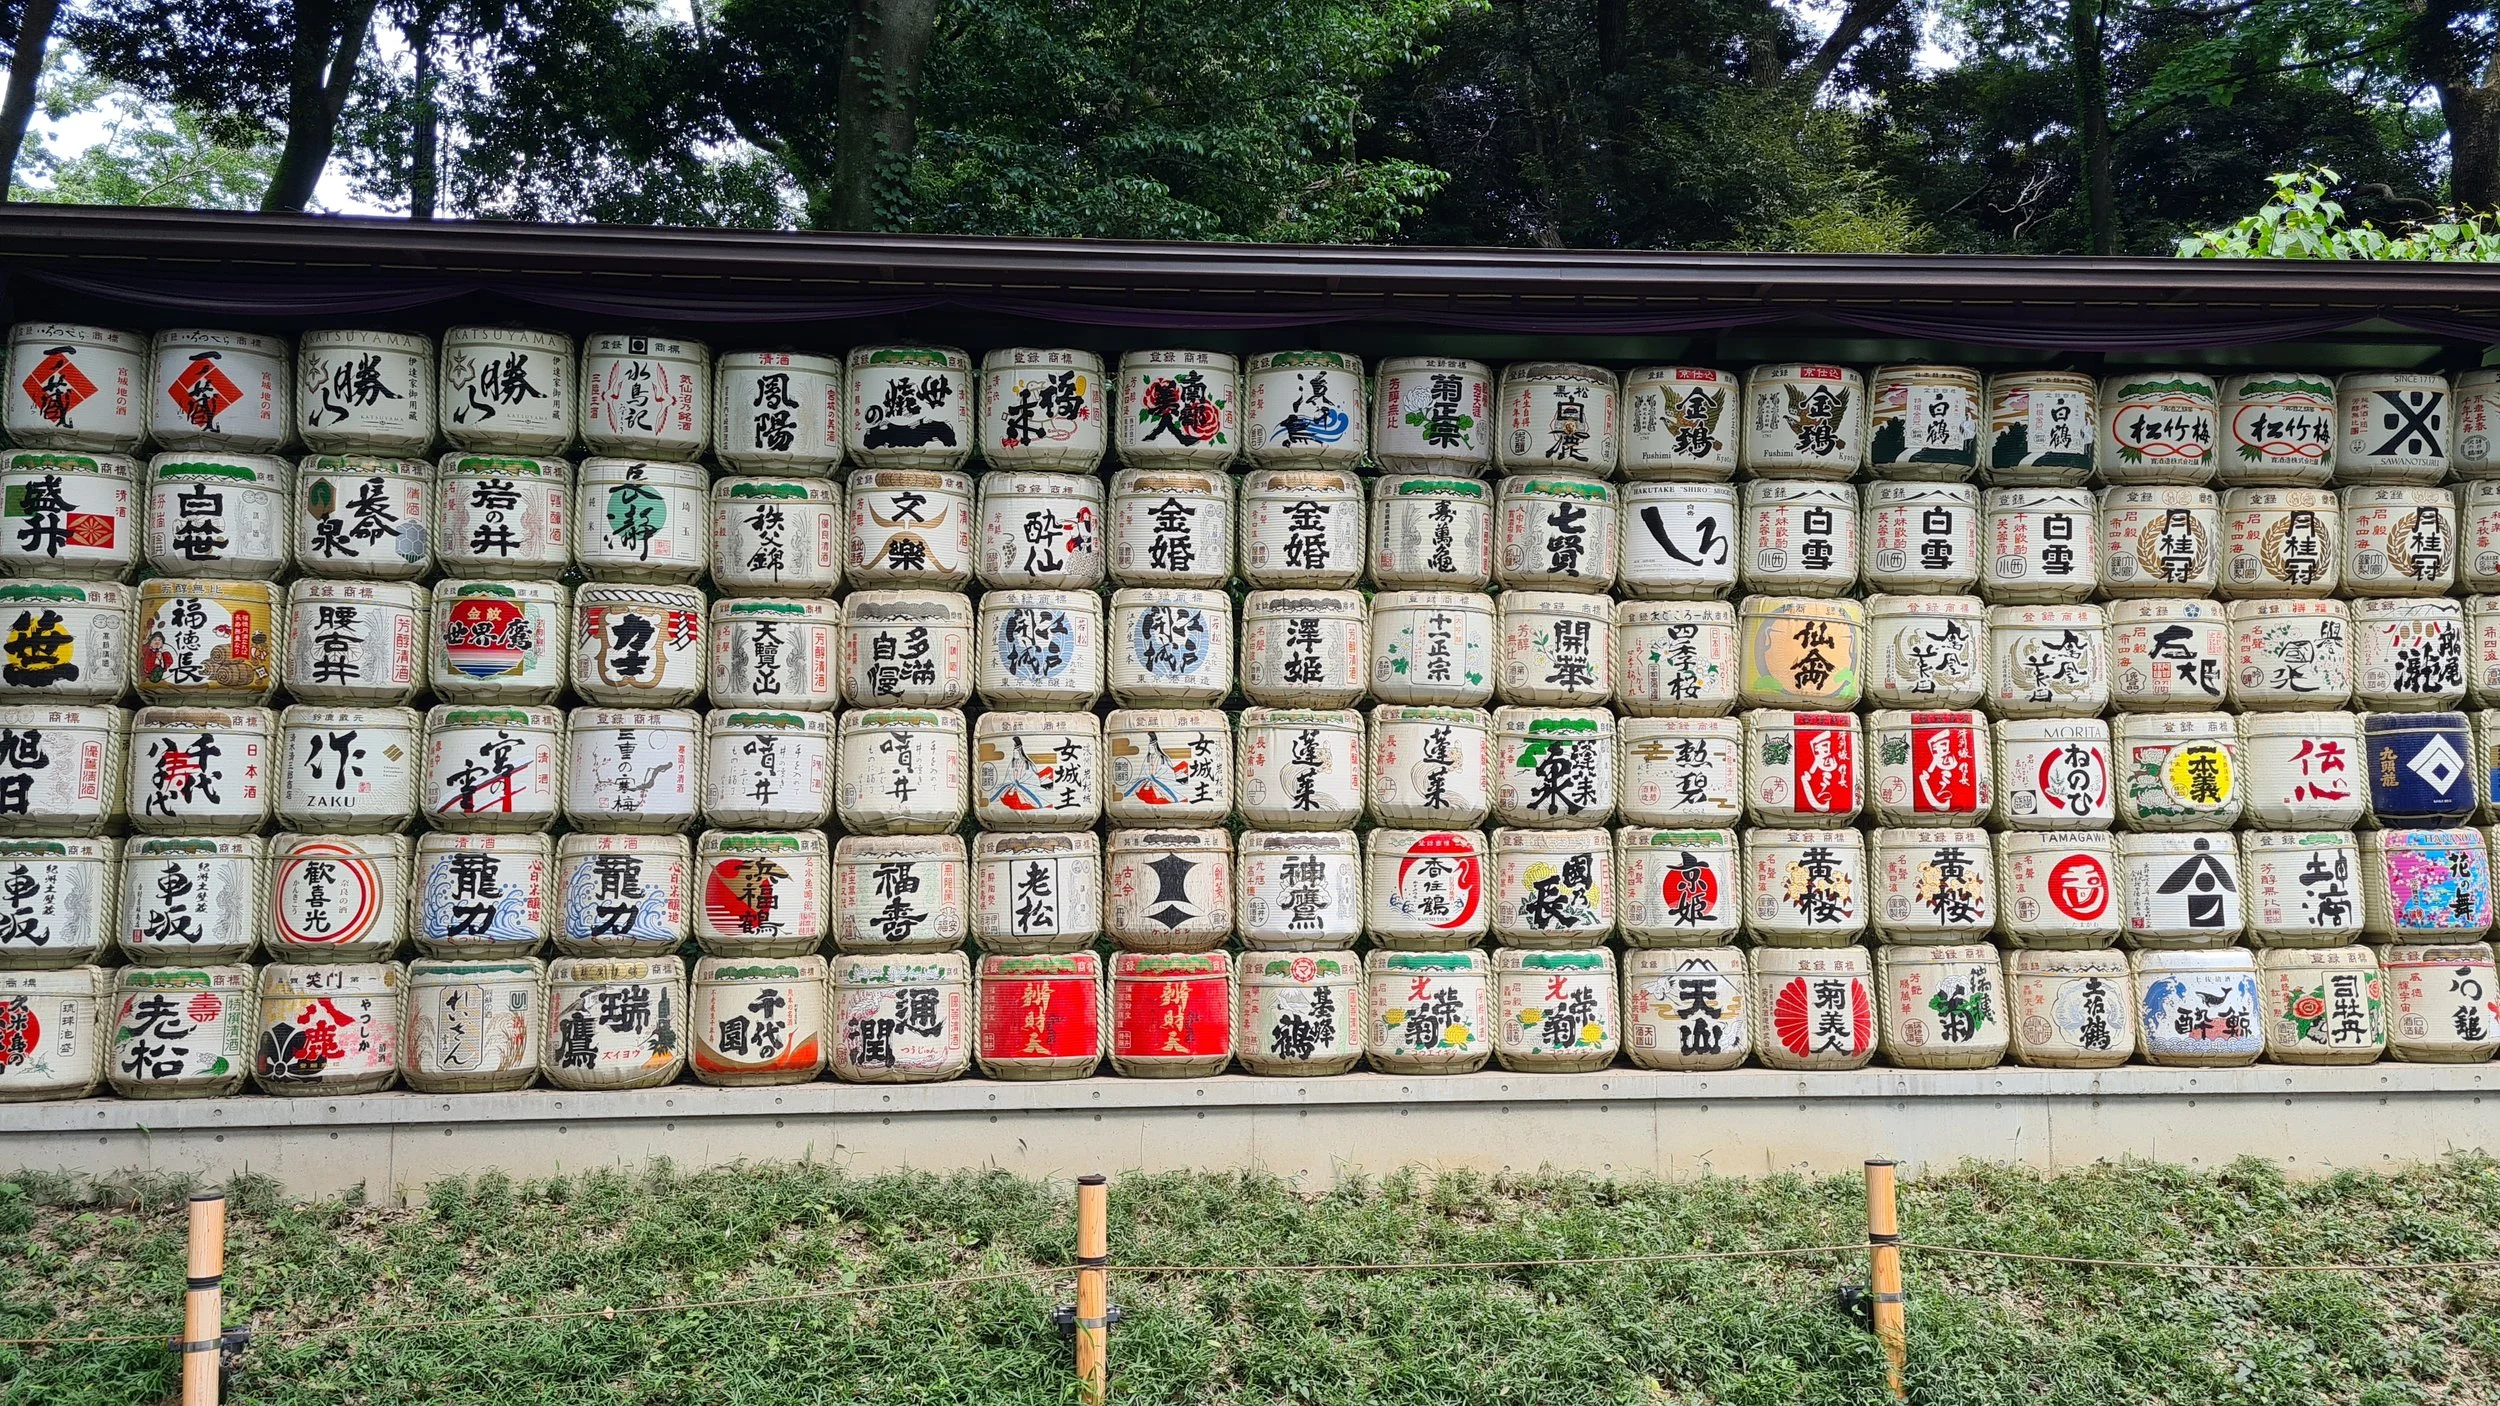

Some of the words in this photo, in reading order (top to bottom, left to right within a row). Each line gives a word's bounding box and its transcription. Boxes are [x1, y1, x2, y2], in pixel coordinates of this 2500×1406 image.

[308, 329, 412, 348] KATSUYAMA
[454, 329, 556, 347] KATSUYAMA
[759, 353, 791, 366] 清酒
[116, 367, 129, 415] 宮城地の酒
[261, 371, 274, 420] 宮城地の酒
[624, 361, 653, 431] 水鳥記
[1553, 384, 1591, 398] 黒松
[1679, 369, 1714, 381] 京仕込
[1804, 369, 1840, 381] 京仕込
[2394, 374, 2418, 385] SINCE
[2420, 376, 2437, 385] 1717
[753, 373, 799, 452] 鳳陽
[1428, 374, 1464, 450] 菊正宗
[1925, 392, 1952, 448] 白鶴
[2047, 397, 2074, 453] 白鶴
[2129, 413, 2212, 444] 松竹梅
[2249, 412, 2331, 445] 松竹梅
[100, 463, 128, 476] 商標
[1642, 451, 1672, 463] Fushimi
[1763, 449, 1794, 461] Fushimi
[2380, 457, 2441, 468] SAWANOTSURU
[16, 474, 80, 558] 盛升
[115, 489, 128, 518] 清酒
[406, 483, 421, 516] 清酒
[470, 478, 522, 557] 岩の井
[681, 501, 692, 537] 埼玉
[1633, 486, 1675, 498] HAKUTAKE
[172, 483, 230, 561] 白笹
[743, 505, 785, 582] 秩父錦
[1023, 508, 1065, 577] 酔仙
[1146, 497, 1196, 572] 金婚
[1283, 499, 1331, 570] 金婚
[1546, 501, 1587, 577] 七賢
[1640, 505, 1729, 567] しろ
[1801, 505, 1838, 571] 白雪
[1920, 505, 1957, 571] 白雪
[2041, 512, 2076, 577] 白雪
[2159, 508, 2195, 583] 月桂冠
[2283, 511, 2319, 585] 月桂冠
[2408, 506, 2442, 582] 月桂冠
[88, 592, 117, 604] 商標
[344, 587, 375, 601] 商標
[2139, 606, 2169, 617] 登録
[168, 597, 209, 684] 福徳長
[314, 605, 365, 685] 腰古井
[395, 615, 413, 679] 芳醇清酒
[608, 615, 656, 679] 力士
[1283, 618, 1325, 686] 澤姫
[1427, 612, 1454, 683] 十一正宗
[1544, 619, 1597, 693] 開華
[1667, 622, 1702, 700] 四季桜
[1711, 631, 1722, 662] 日本酒
[48, 710, 81, 724] 商標
[232, 714, 259, 726] 商標
[2043, 726, 2101, 739] MORITA
[2163, 720, 2194, 733] 登録
[244, 743, 257, 800] 日本酒
[307, 730, 367, 791] 作
[537, 751, 550, 786] 清酒
[612, 728, 648, 813] 三重の寒梅
[1054, 739, 1082, 811] 女城主
[1187, 733, 1215, 805] 女城主
[2065, 743, 2095, 816] ねのひ
[2186, 747, 2222, 803] 一本義
[2288, 739, 2351, 803] 伝心
[308, 794, 356, 808] ZAKU
[68, 844, 94, 856] 商標
[219, 843, 245, 855] 商標
[455, 836, 496, 850] 清酒
[599, 836, 639, 850] 清酒
[2041, 832, 2106, 844] TAMAGAWA
[2261, 835, 2297, 847] 登録
[0, 861, 51, 946] 車坂
[143, 859, 203, 944] 車坂
[302, 860, 338, 933] 歓喜光
[446, 852, 502, 937] 龍力
[591, 852, 646, 936] 龍力
[1017, 860, 1054, 932] 老松
[1416, 857, 1453, 915] 香住鶴
[1666, 851, 1718, 928] 京姫
[2260, 863, 2280, 907] 芳醇無比
[2448, 852, 2476, 920] 花の舞
[213, 975, 242, 988] 商標
[306, 970, 344, 990] 笑門
[60, 1003, 75, 1055] 琉球泡盛
[122, 994, 201, 1080] 老松
[358, 997, 371, 1053] やつしか
[1678, 978, 1722, 1056] 天山
[1810, 979, 1853, 1057] 菊美人
[2081, 977, 2111, 1050] 土佐鶴
[2331, 975, 2368, 1045] 司牡丹
[602, 1048, 642, 1061] ズイヨウ
